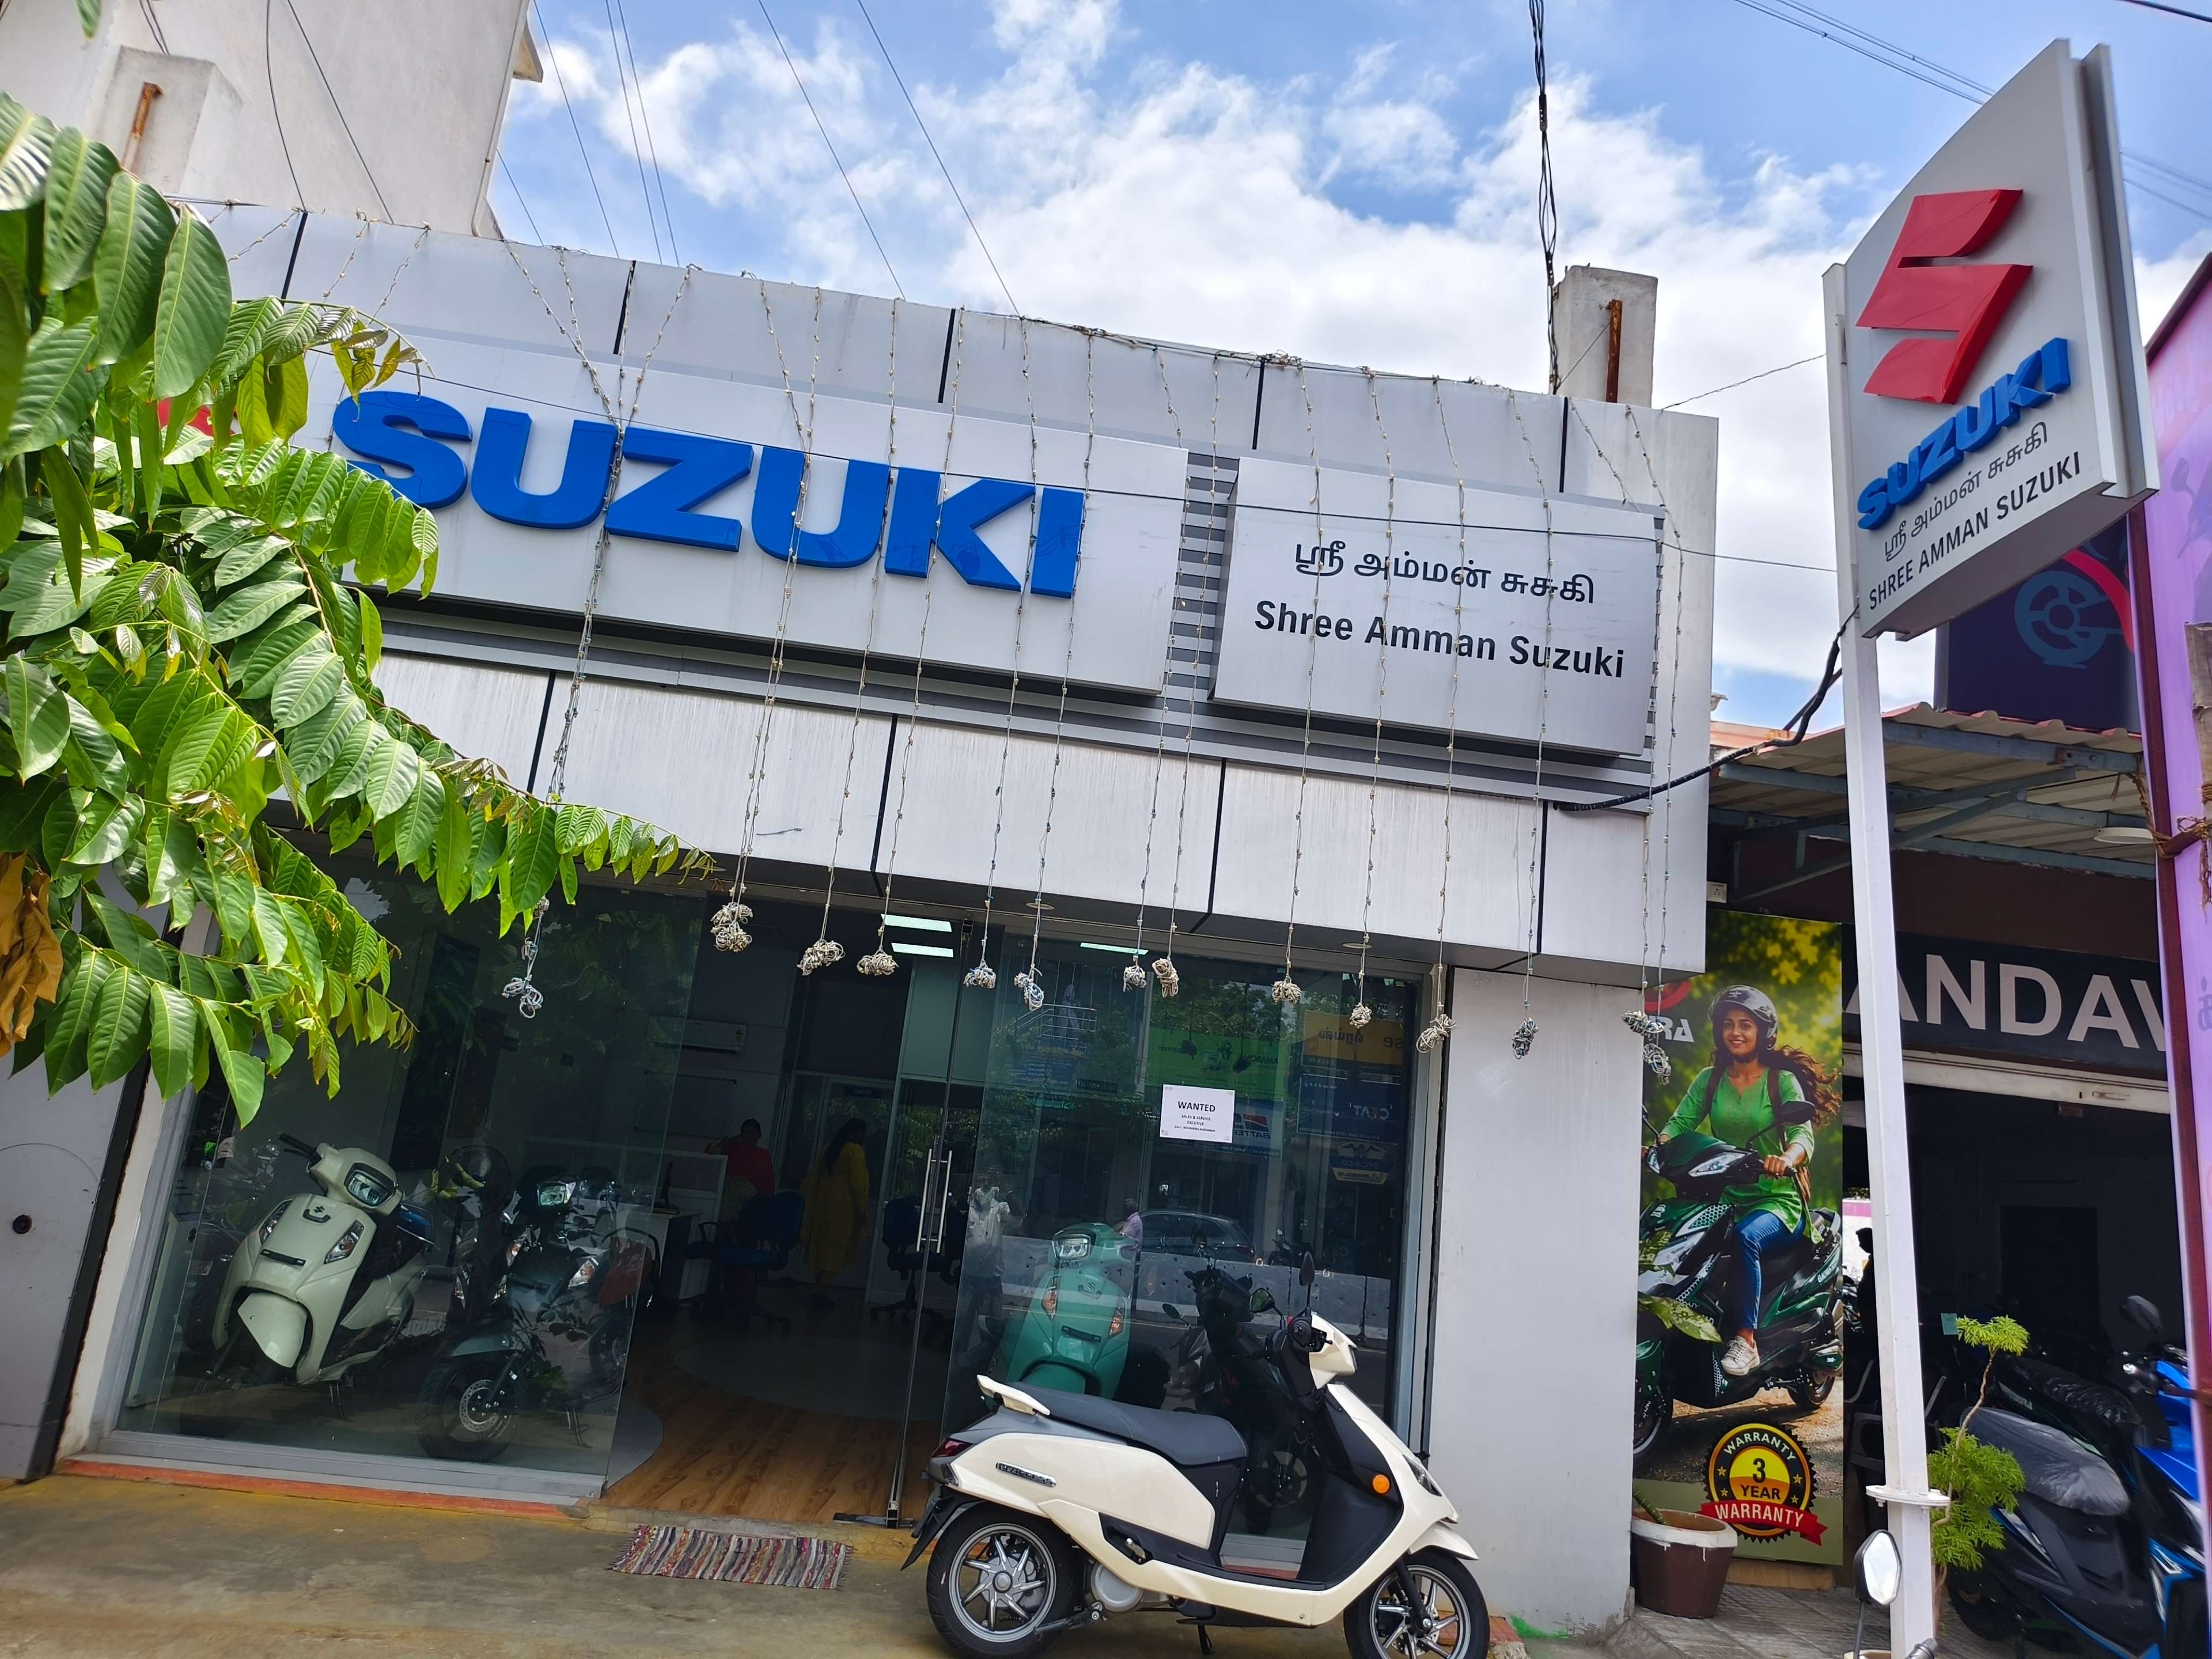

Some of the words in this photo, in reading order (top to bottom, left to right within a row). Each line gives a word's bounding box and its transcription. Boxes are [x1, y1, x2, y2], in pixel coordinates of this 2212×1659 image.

[1857, 338, 2071, 530] SUZUKI
[332, 390, 1085, 598] SUZUKI
[1911, 470, 1982, 537] அம்மன்
[1987, 421, 2047, 480] சுசுகி
[1869, 559, 1913, 610] SHREE
[1919, 507, 1988, 573] AMMAN
[1997, 451, 2080, 520] SUZUKI
[1354, 551, 1491, 589] அம்மன்
[1501, 573, 1594, 604] சுசுகி
[1255, 600, 1353, 640] Shree
[1364, 616, 1496, 661] Amman
[1509, 635, 1624, 678] Suzuki
[1178, 1101, 1215, 1112] WANTED
[1724, 1431, 1797, 1461] WARRANTY
[1752, 1458, 1766, 1483] 3
[1714, 1503, 1804, 1527] WARRANTY
[1740, 1484, 1781, 1500] YEAR
